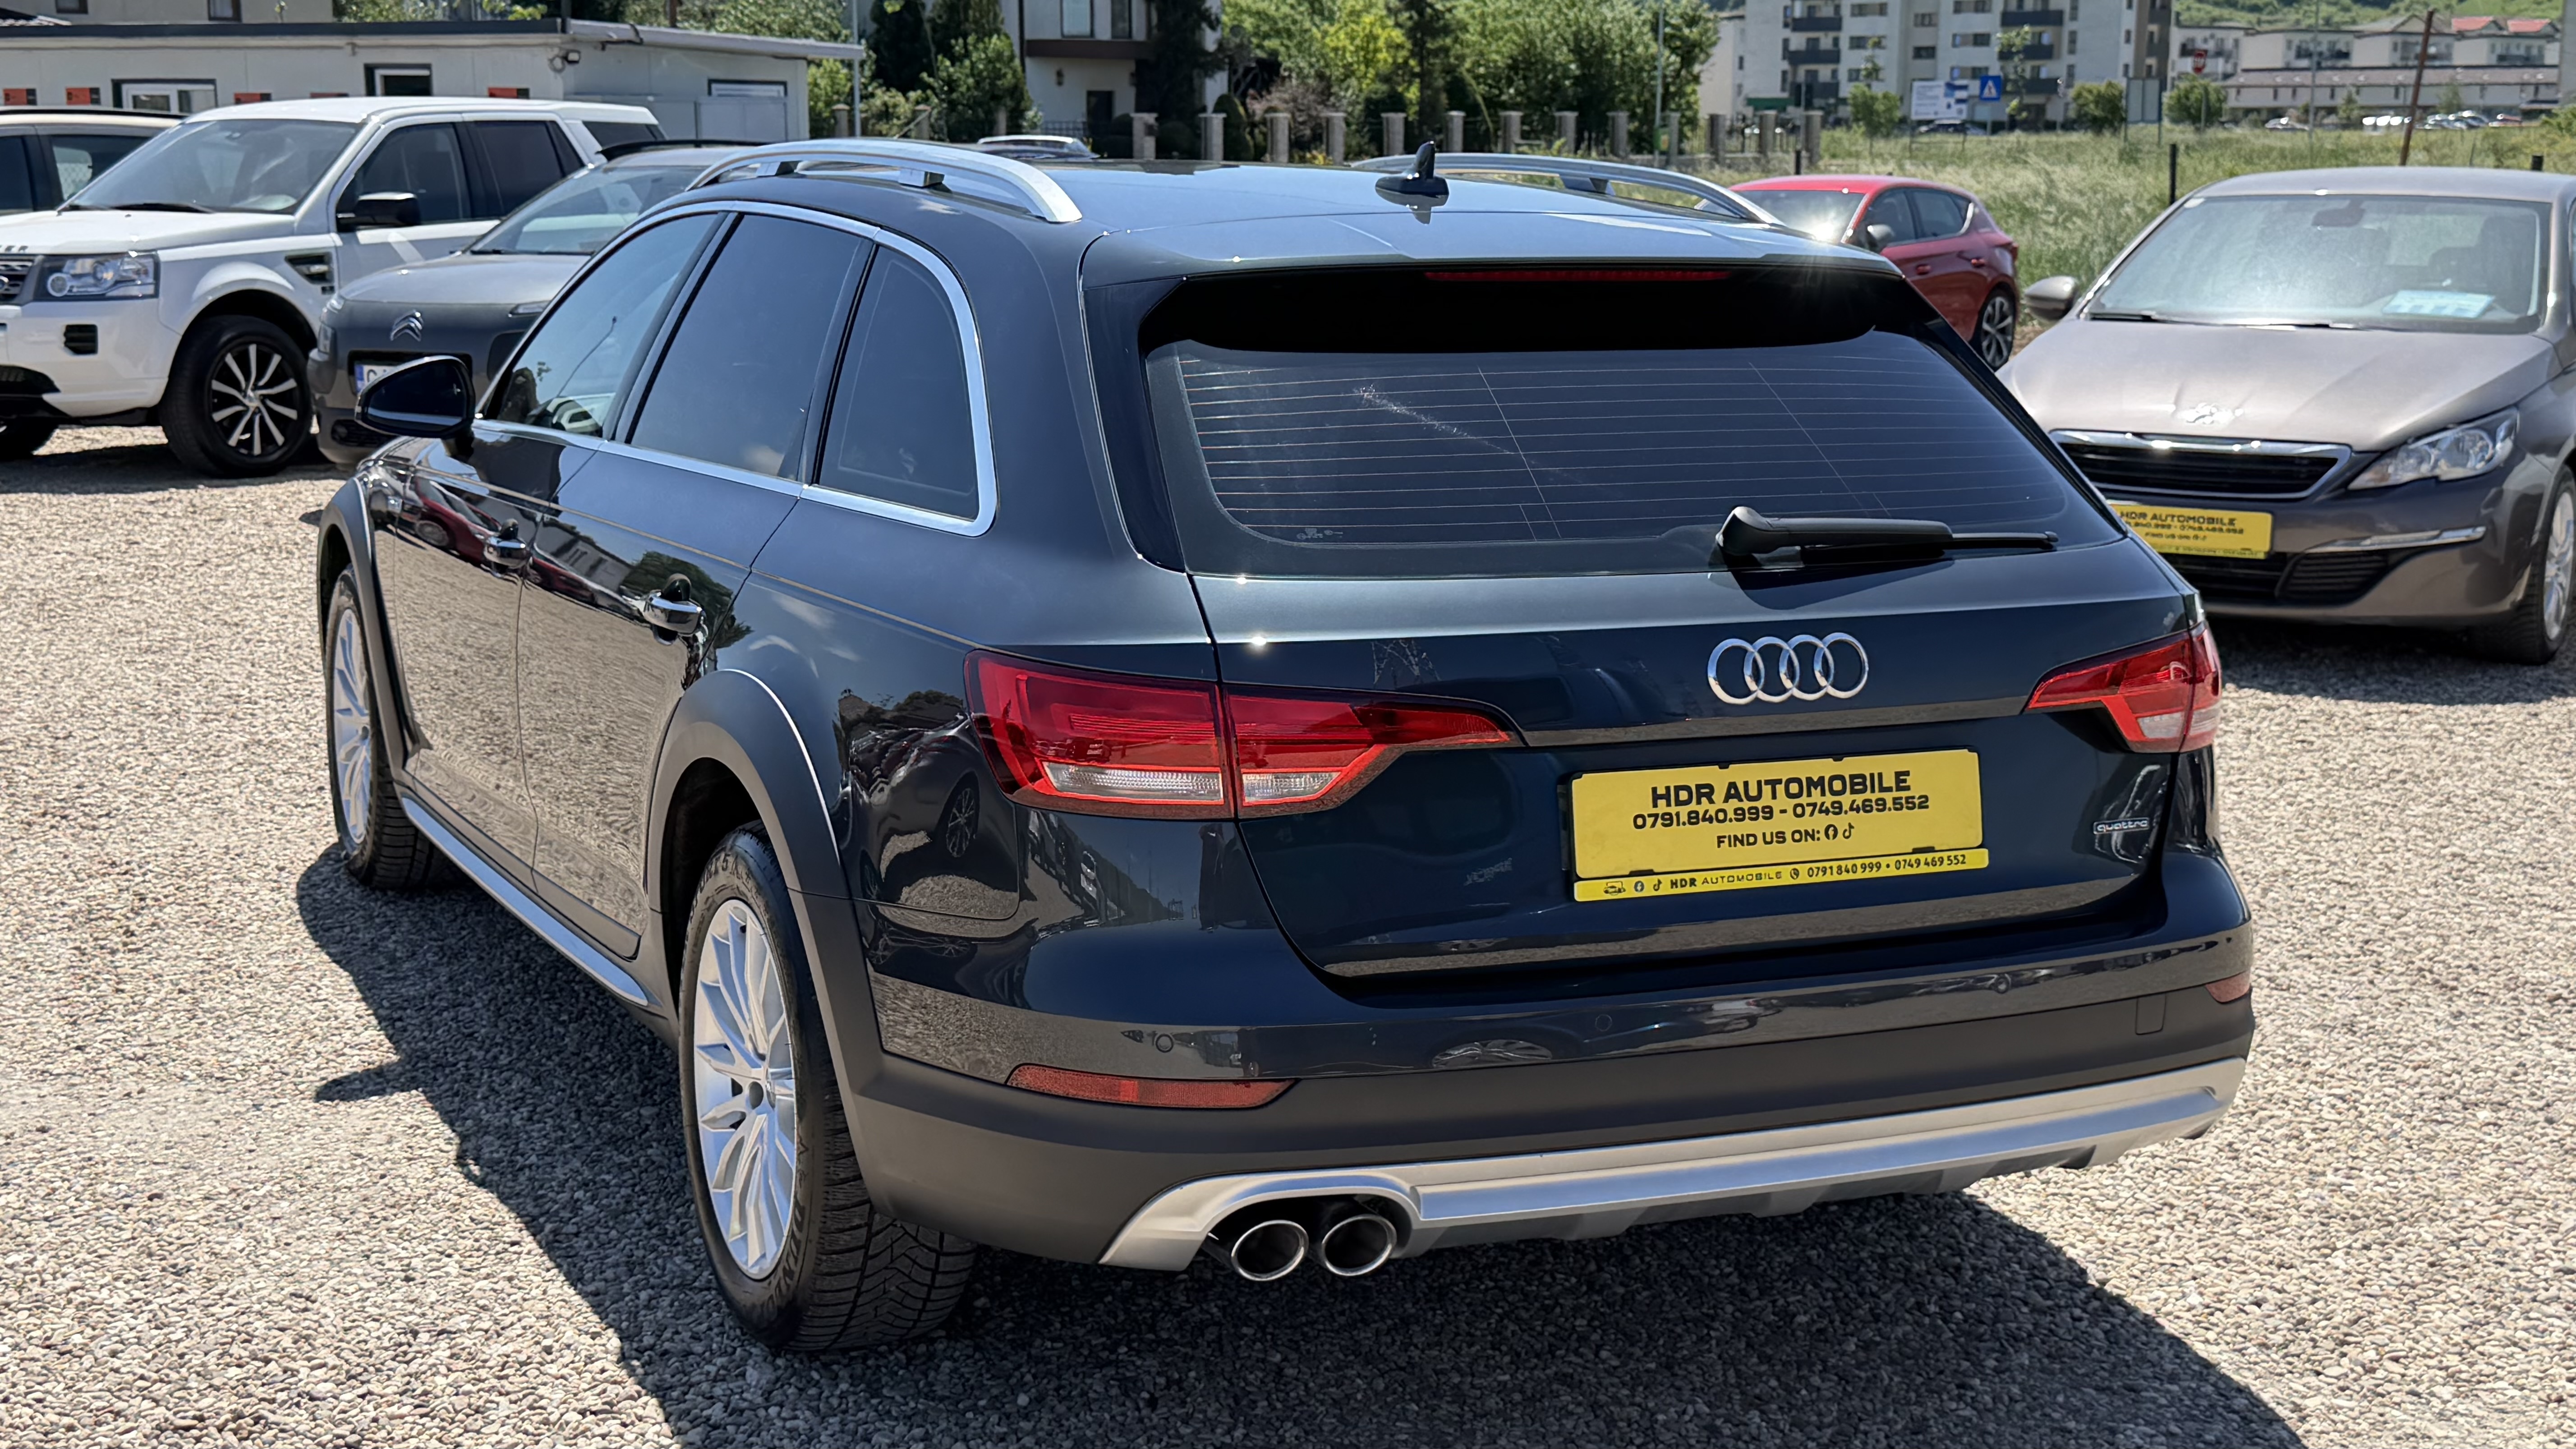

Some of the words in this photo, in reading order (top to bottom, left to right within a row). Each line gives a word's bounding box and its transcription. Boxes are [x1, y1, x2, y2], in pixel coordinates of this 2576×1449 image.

[2151, 513, 2237, 526] AUTOMOBILE
[1651, 783, 1716, 809] HDR
[1722, 770, 1911, 804] AUTOMOBILE
[1633, 805, 1774, 829] 0791.840.999
[1792, 794, 1929, 818] 0749.469.552
[1716, 833, 1758, 848] FIND
[1762, 830, 1787, 845] US
[1791, 828, 1821, 843] ON:
[2097, 820, 2148, 833] quattro
[1670, 877, 1697, 889] HDR
[1701, 871, 1782, 885] AUTOMOBILE
[1860, 861, 1881, 873] 999
[1895, 858, 1921, 870] 0749
[1923, 856, 1944, 868] 469
[1946, 854, 1966, 865] 552
